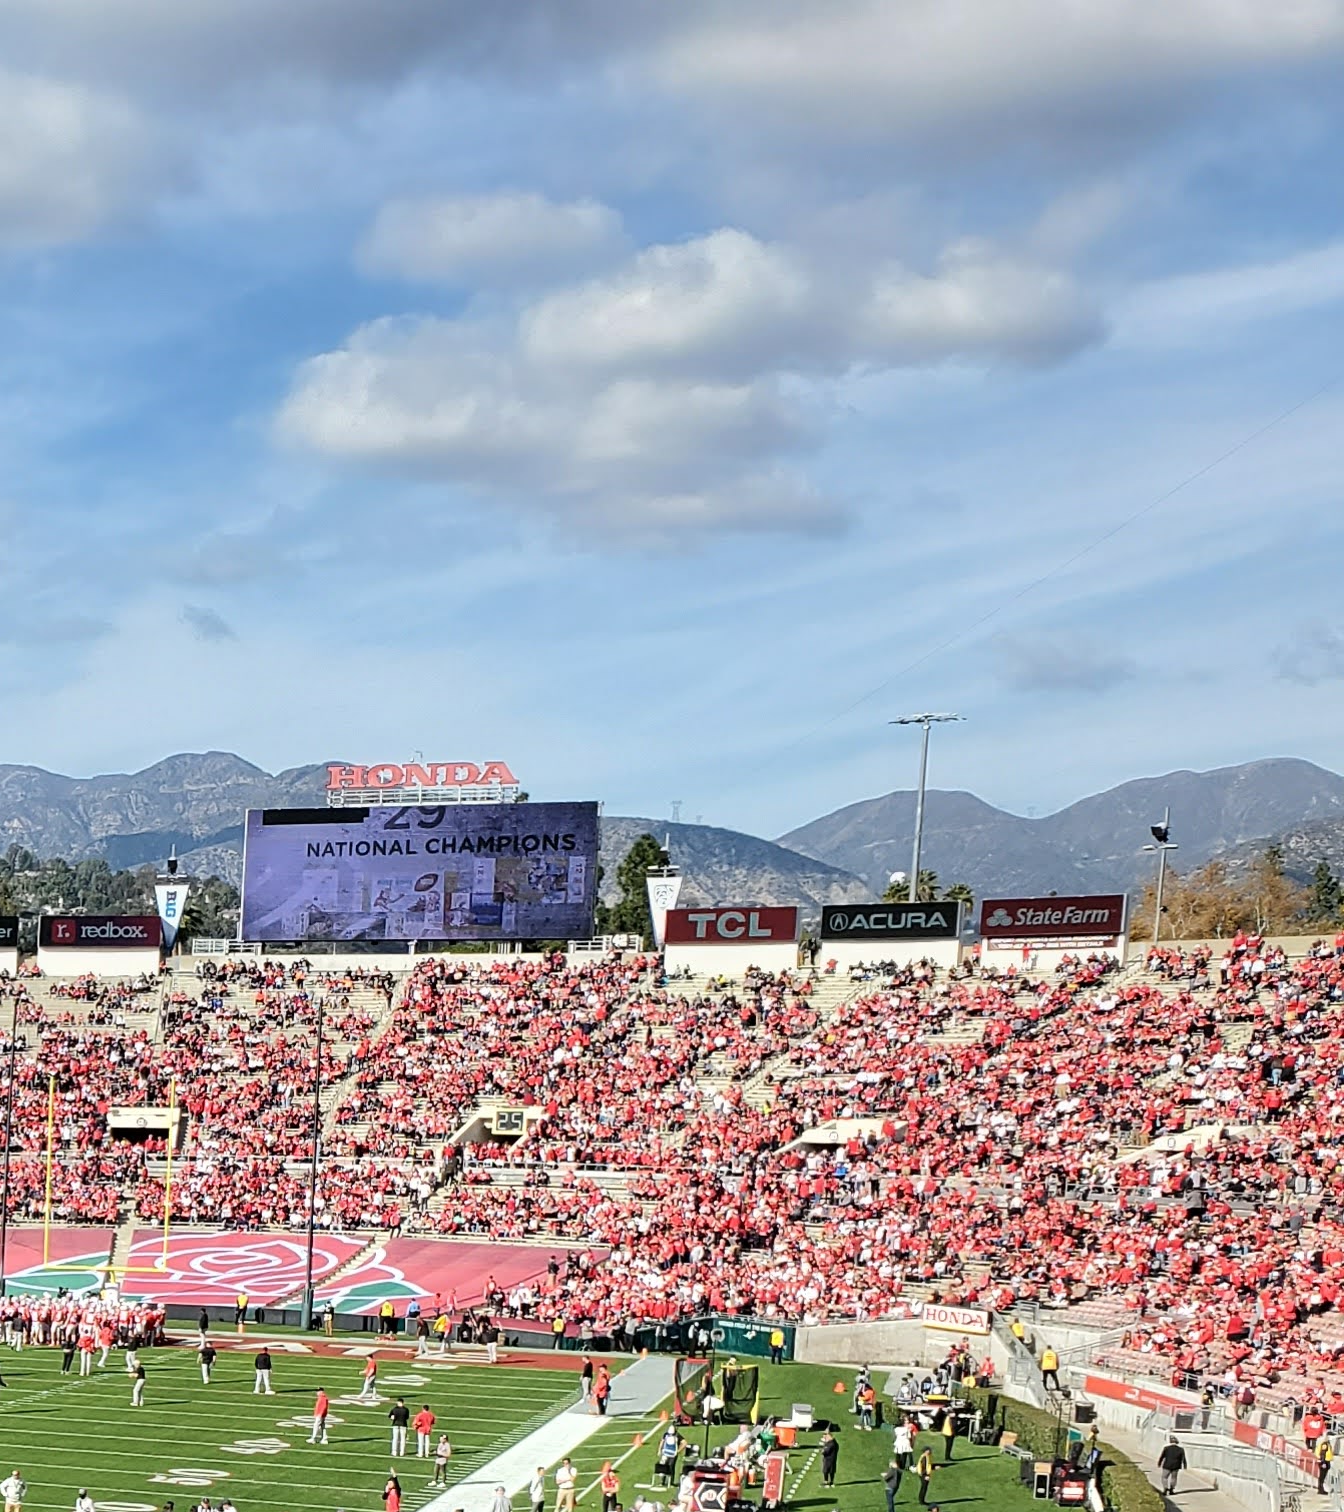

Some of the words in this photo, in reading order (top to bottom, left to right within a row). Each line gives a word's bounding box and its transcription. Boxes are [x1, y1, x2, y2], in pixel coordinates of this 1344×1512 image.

[325, 761, 520, 790] HONDA
[307, 839, 417, 858] NATIONAL
[425, 833, 577, 856] CHAMPIONS
[688, 911, 772, 938] TCL
[851, 911, 948, 930] ACURA
[498, 1112, 521, 1130] 25
[926, 1307, 984, 1328] HONDA
[148, 1468, 230, 1486] 50
